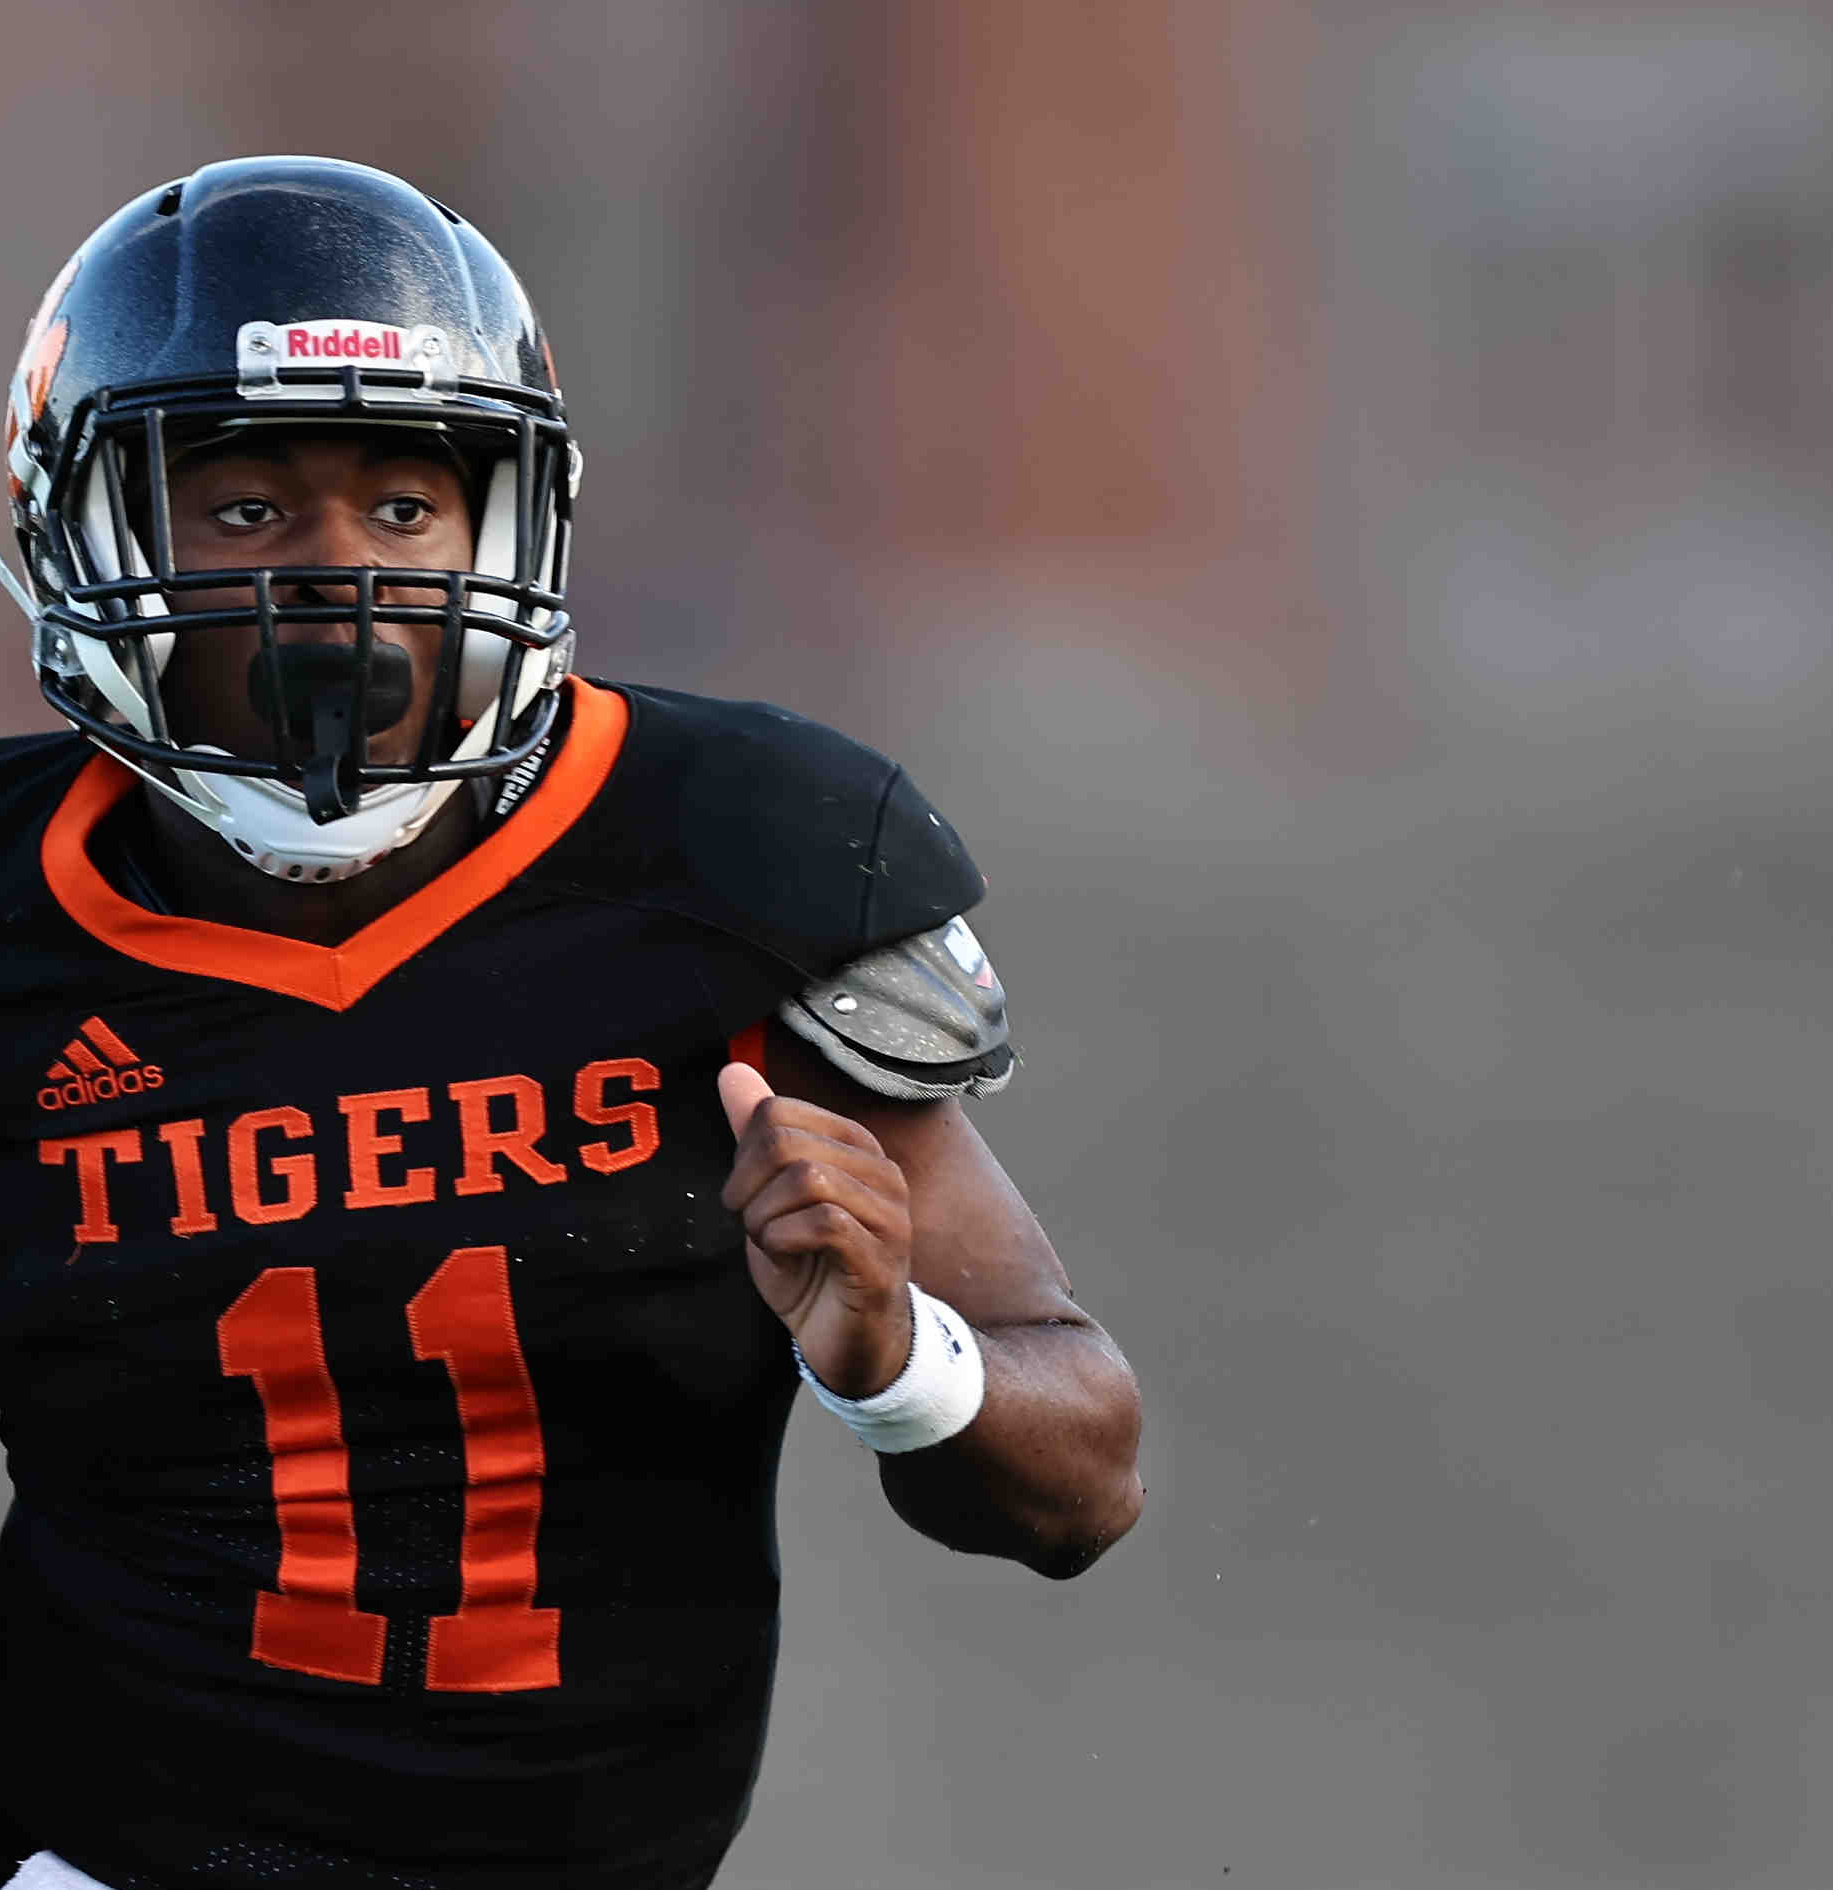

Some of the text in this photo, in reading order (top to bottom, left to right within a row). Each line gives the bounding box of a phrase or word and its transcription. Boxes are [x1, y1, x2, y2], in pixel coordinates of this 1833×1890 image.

[287, 329, 402, 359] Riddell
[36, 1064, 165, 1111] adidas
[38, 1056, 660, 1244] TIGERS
[216, 1245, 564, 1693] 11
